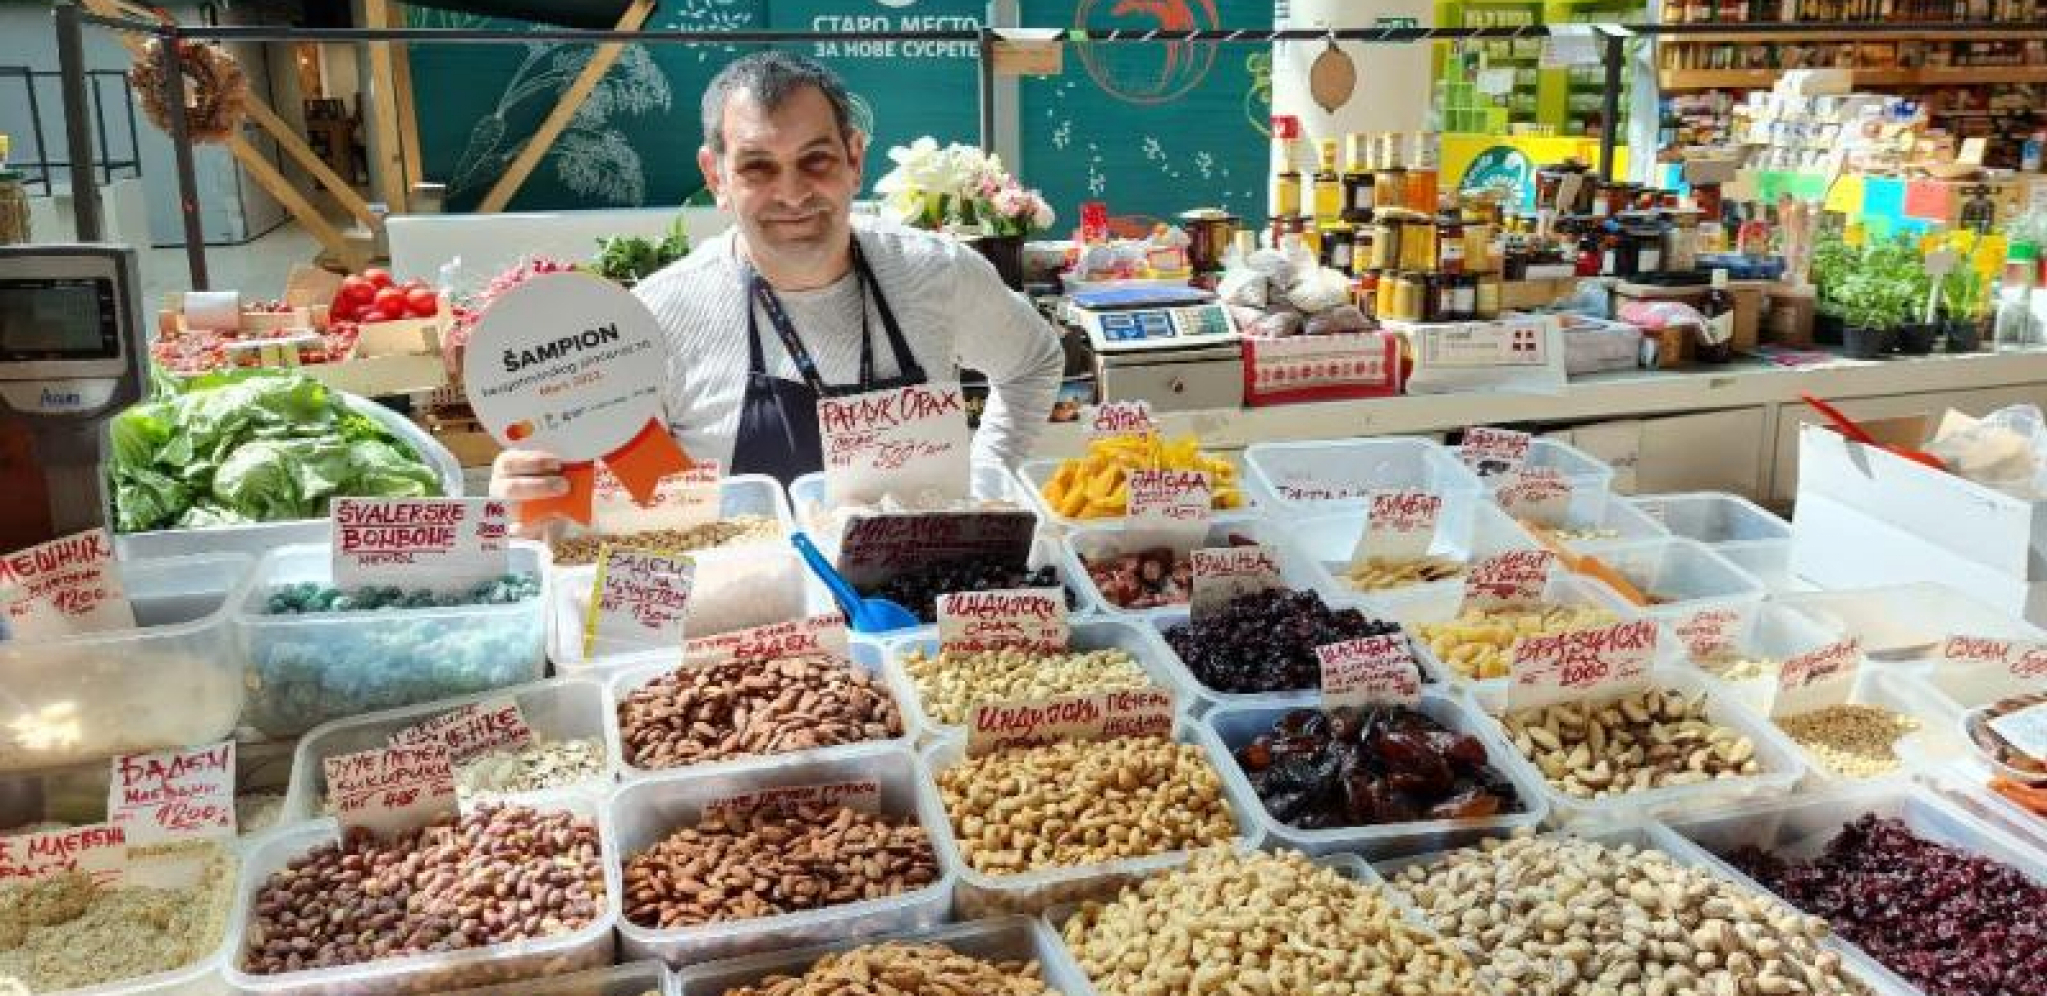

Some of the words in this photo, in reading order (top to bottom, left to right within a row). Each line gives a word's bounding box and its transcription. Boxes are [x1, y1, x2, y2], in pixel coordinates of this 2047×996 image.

[813, 15, 890, 33] СТАРО
[900, 15, 979, 33] МЕСТО
[814, 40, 840, 57] ЗА
[845, 40, 897, 57] НОВЕ
[903, 40, 981, 57] СУСРЕТЕ
[503, 322, 620, 372] ŠAMPION
[337, 499, 466, 525] ŠVALERSKE
[118, 745, 229, 786] БАДЕМ
